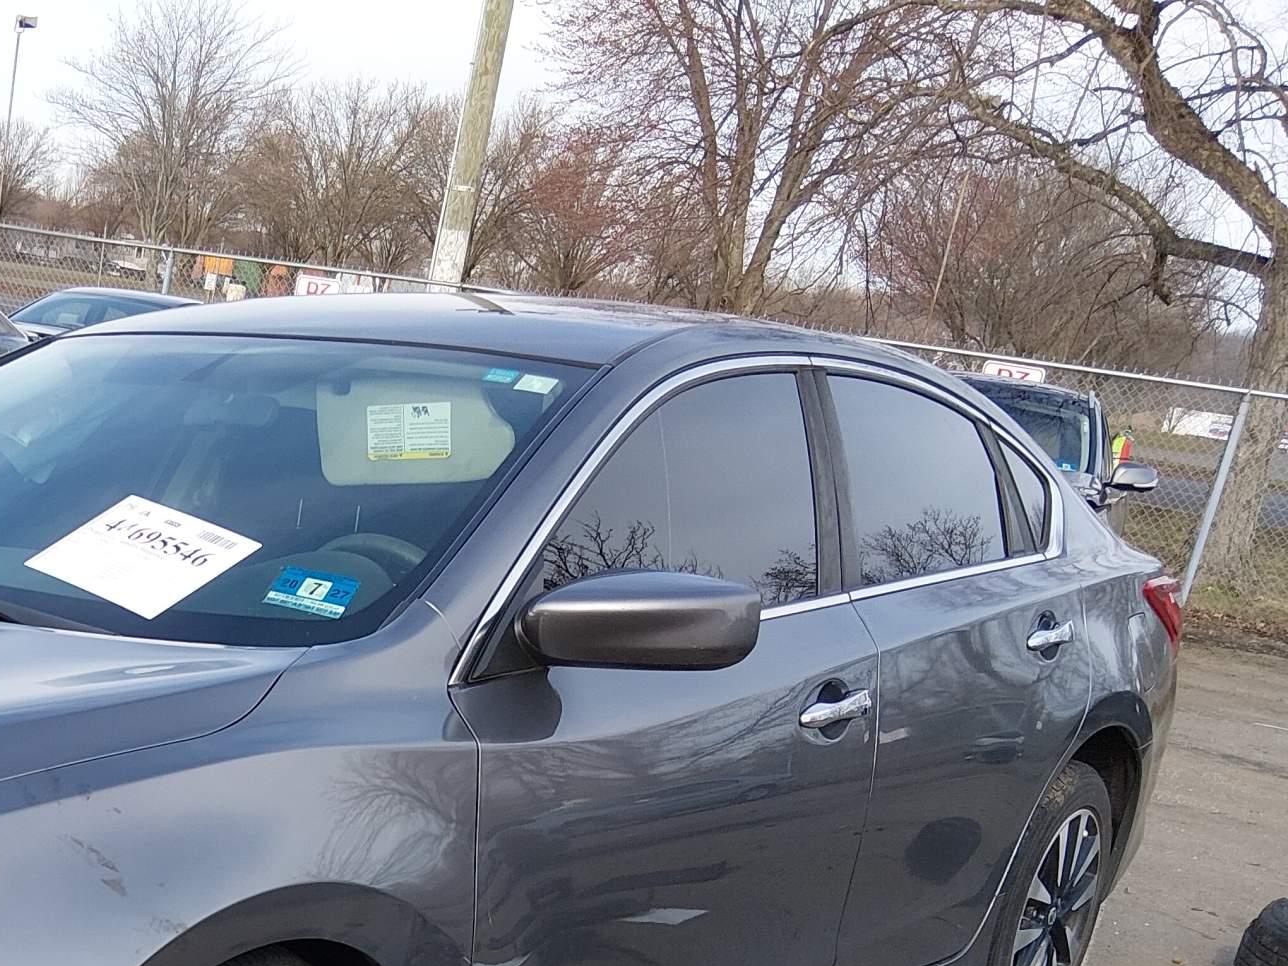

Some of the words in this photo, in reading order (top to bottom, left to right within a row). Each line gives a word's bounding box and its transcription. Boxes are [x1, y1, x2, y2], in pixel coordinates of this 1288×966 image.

[279, 579, 298, 589] 20
[308, 582, 322, 595] 7
[330, 588, 349, 600] 27
